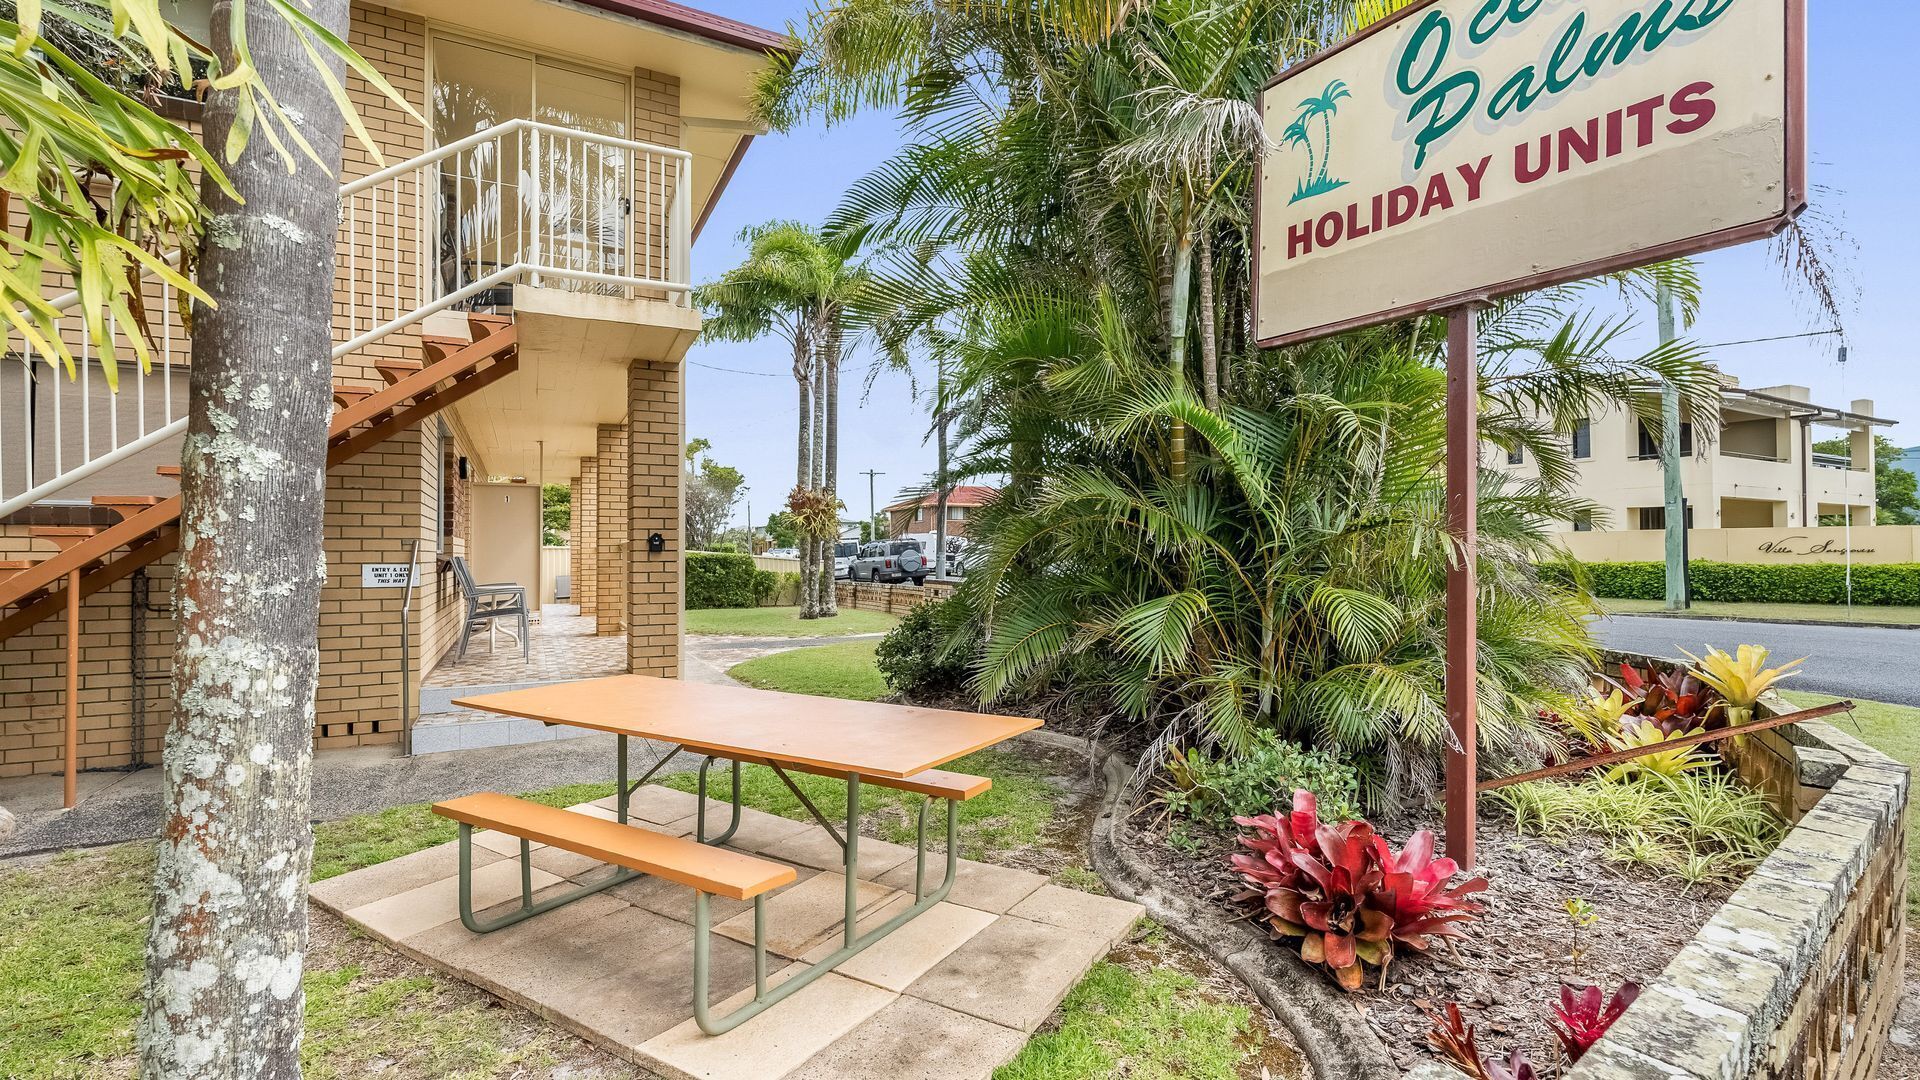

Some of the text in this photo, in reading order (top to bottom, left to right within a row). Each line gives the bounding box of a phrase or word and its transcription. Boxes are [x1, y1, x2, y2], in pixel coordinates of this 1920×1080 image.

[1287, 153, 1493, 260] HOLIDAY
[1514, 81, 1717, 184] UNITS
[1758, 535, 1876, 556] Villa Sangovese
